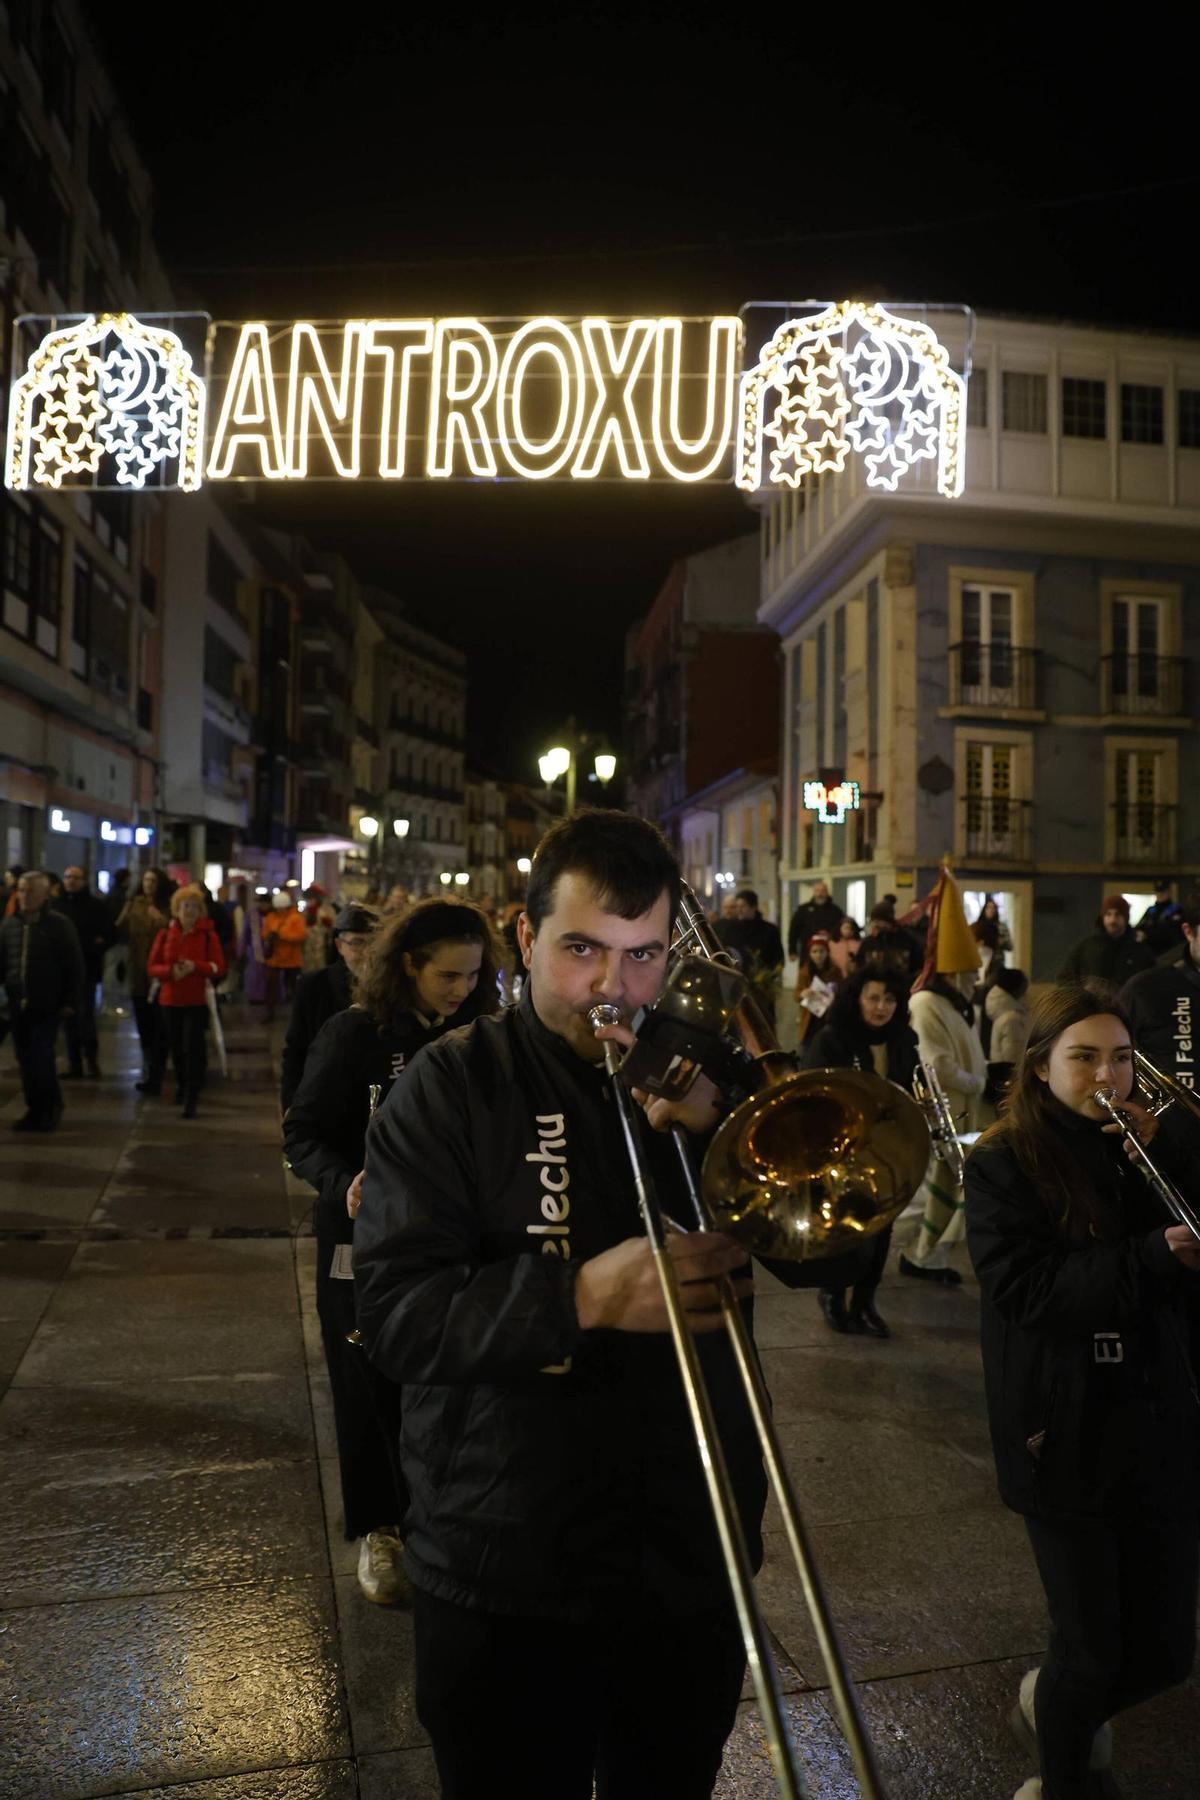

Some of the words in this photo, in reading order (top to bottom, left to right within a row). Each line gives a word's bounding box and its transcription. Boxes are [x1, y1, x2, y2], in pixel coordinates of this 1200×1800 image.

[206, 316, 739, 481] ANTROXU
[1171, 996, 1195, 1063] Felechu
[525, 1113, 571, 1262] elechu
[1093, 1332, 1124, 1363] El
